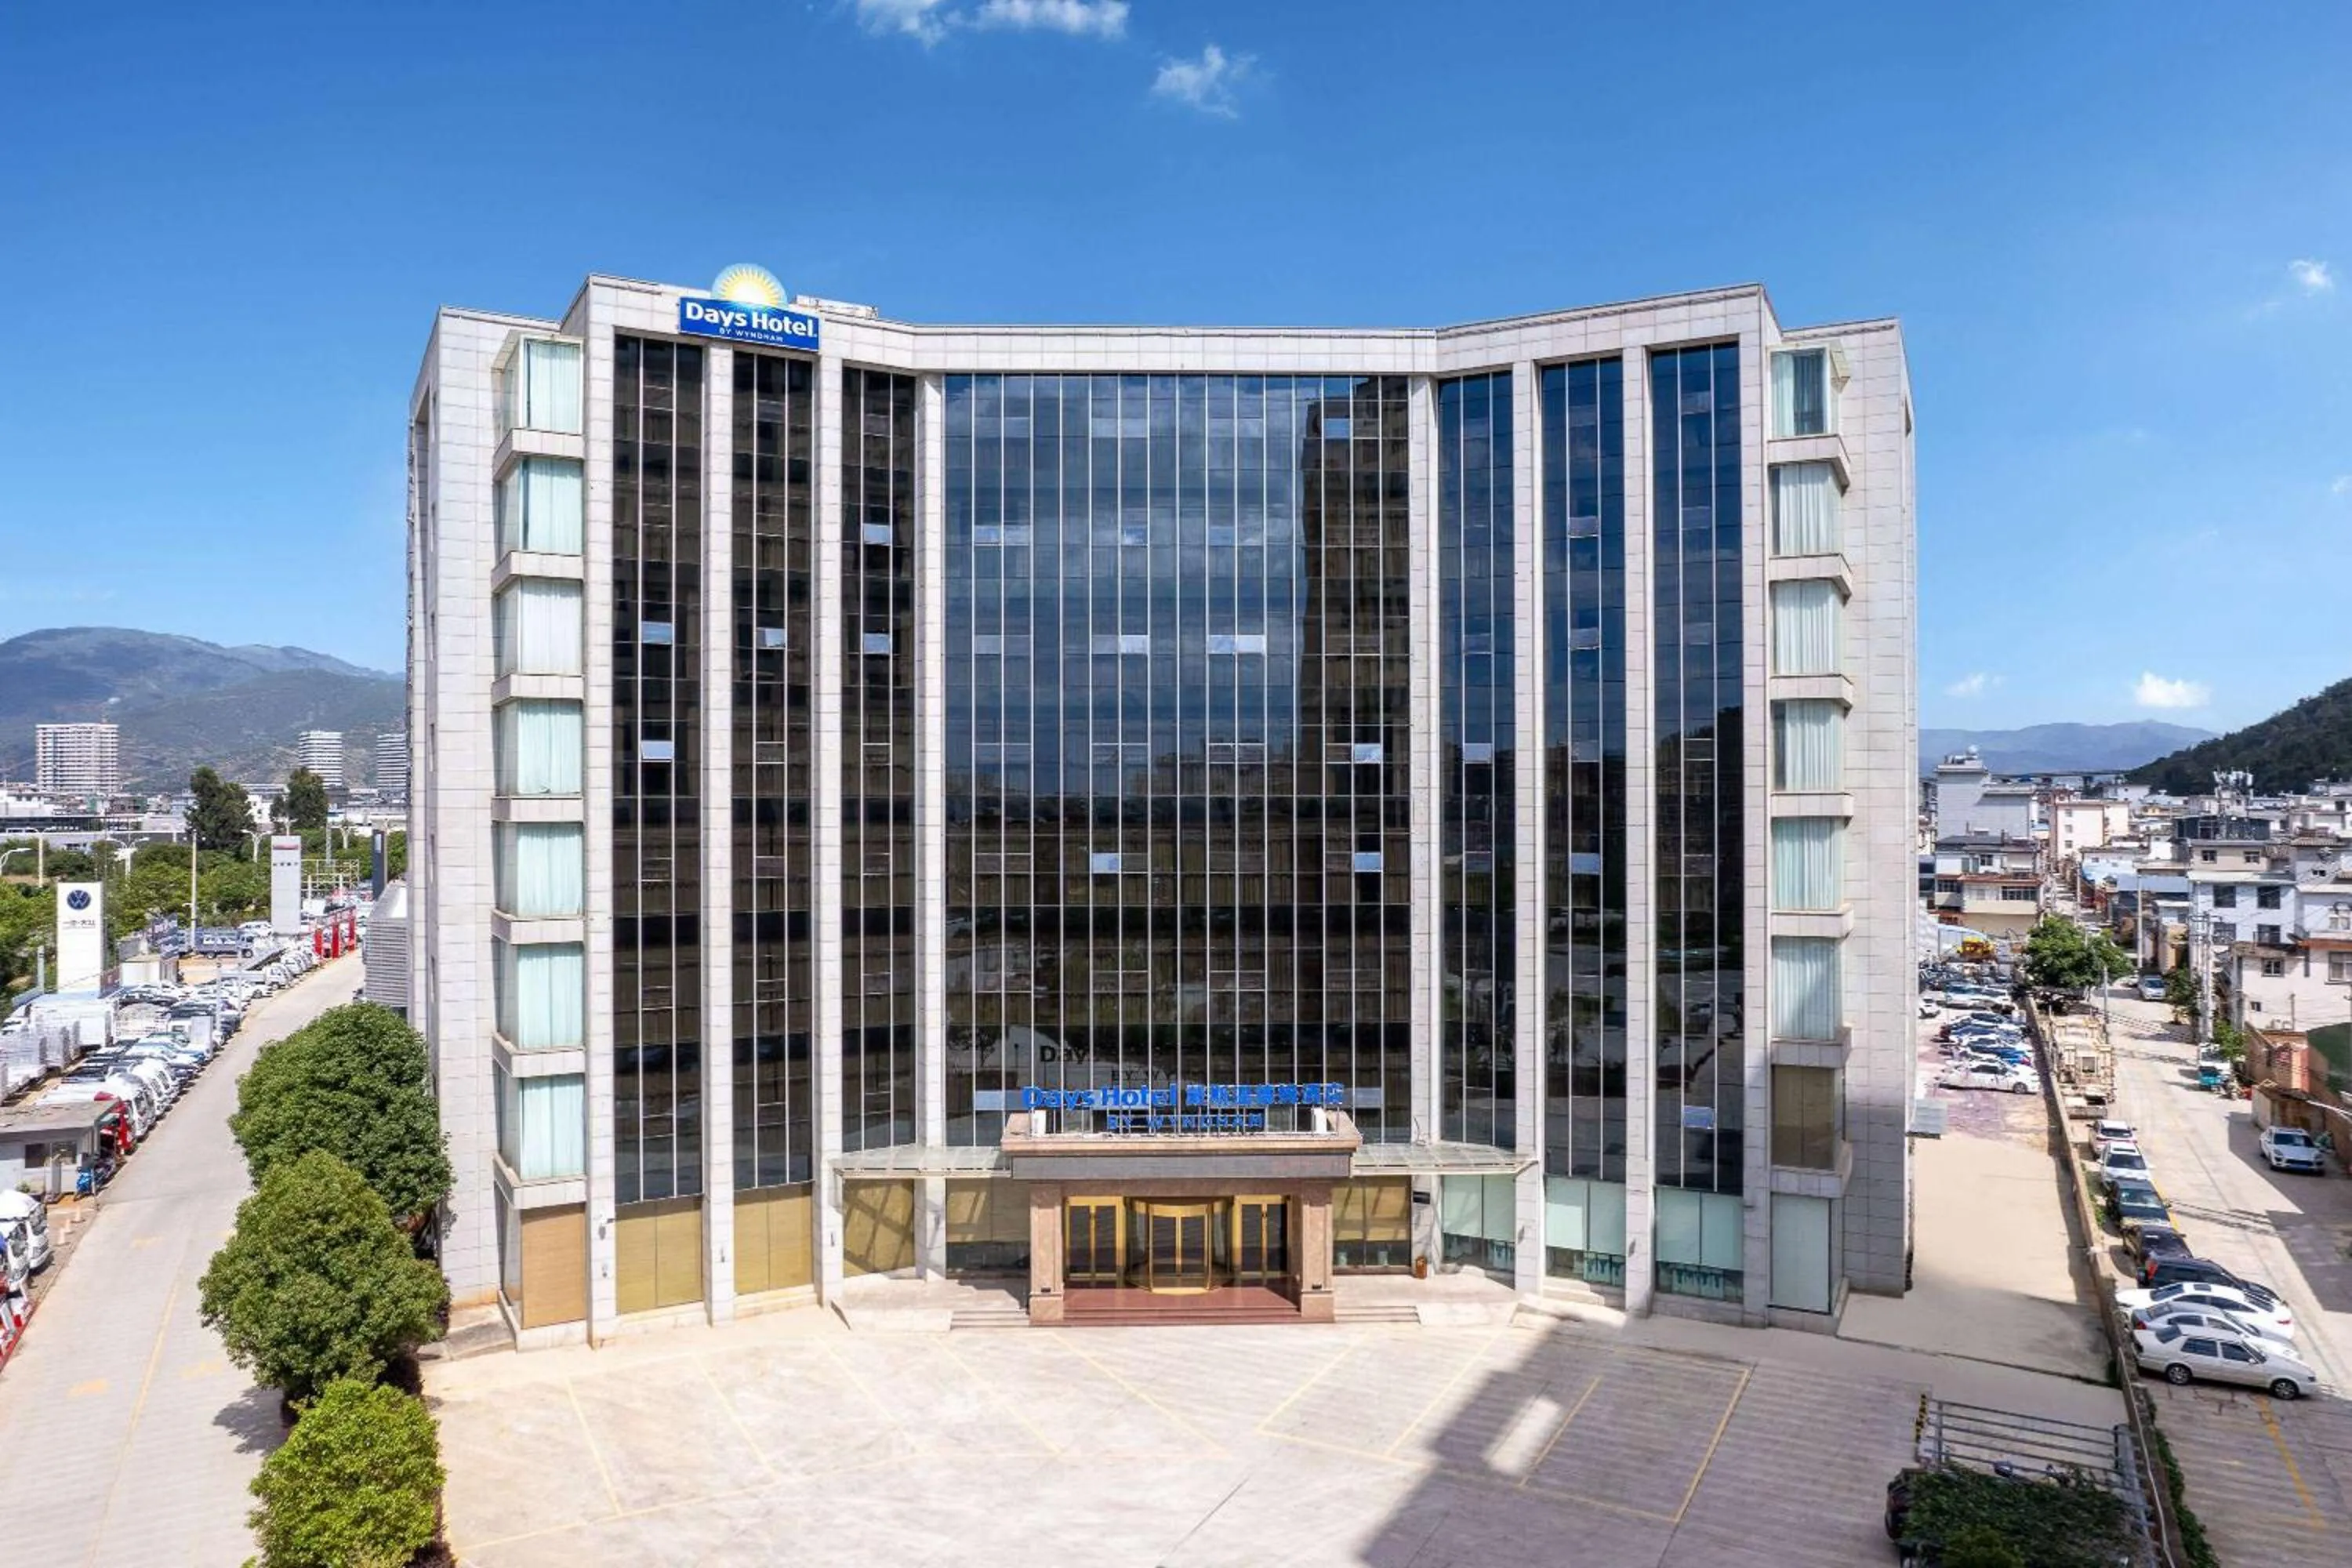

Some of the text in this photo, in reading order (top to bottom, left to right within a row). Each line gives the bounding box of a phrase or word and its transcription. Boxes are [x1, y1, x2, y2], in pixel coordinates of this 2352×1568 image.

[685, 302, 815, 337] Days Hotel
[735, 330, 784, 342] WYNDHAM
[1022, 1086, 1095, 1111] Days
[1101, 1083, 1177, 1106] Hotel
